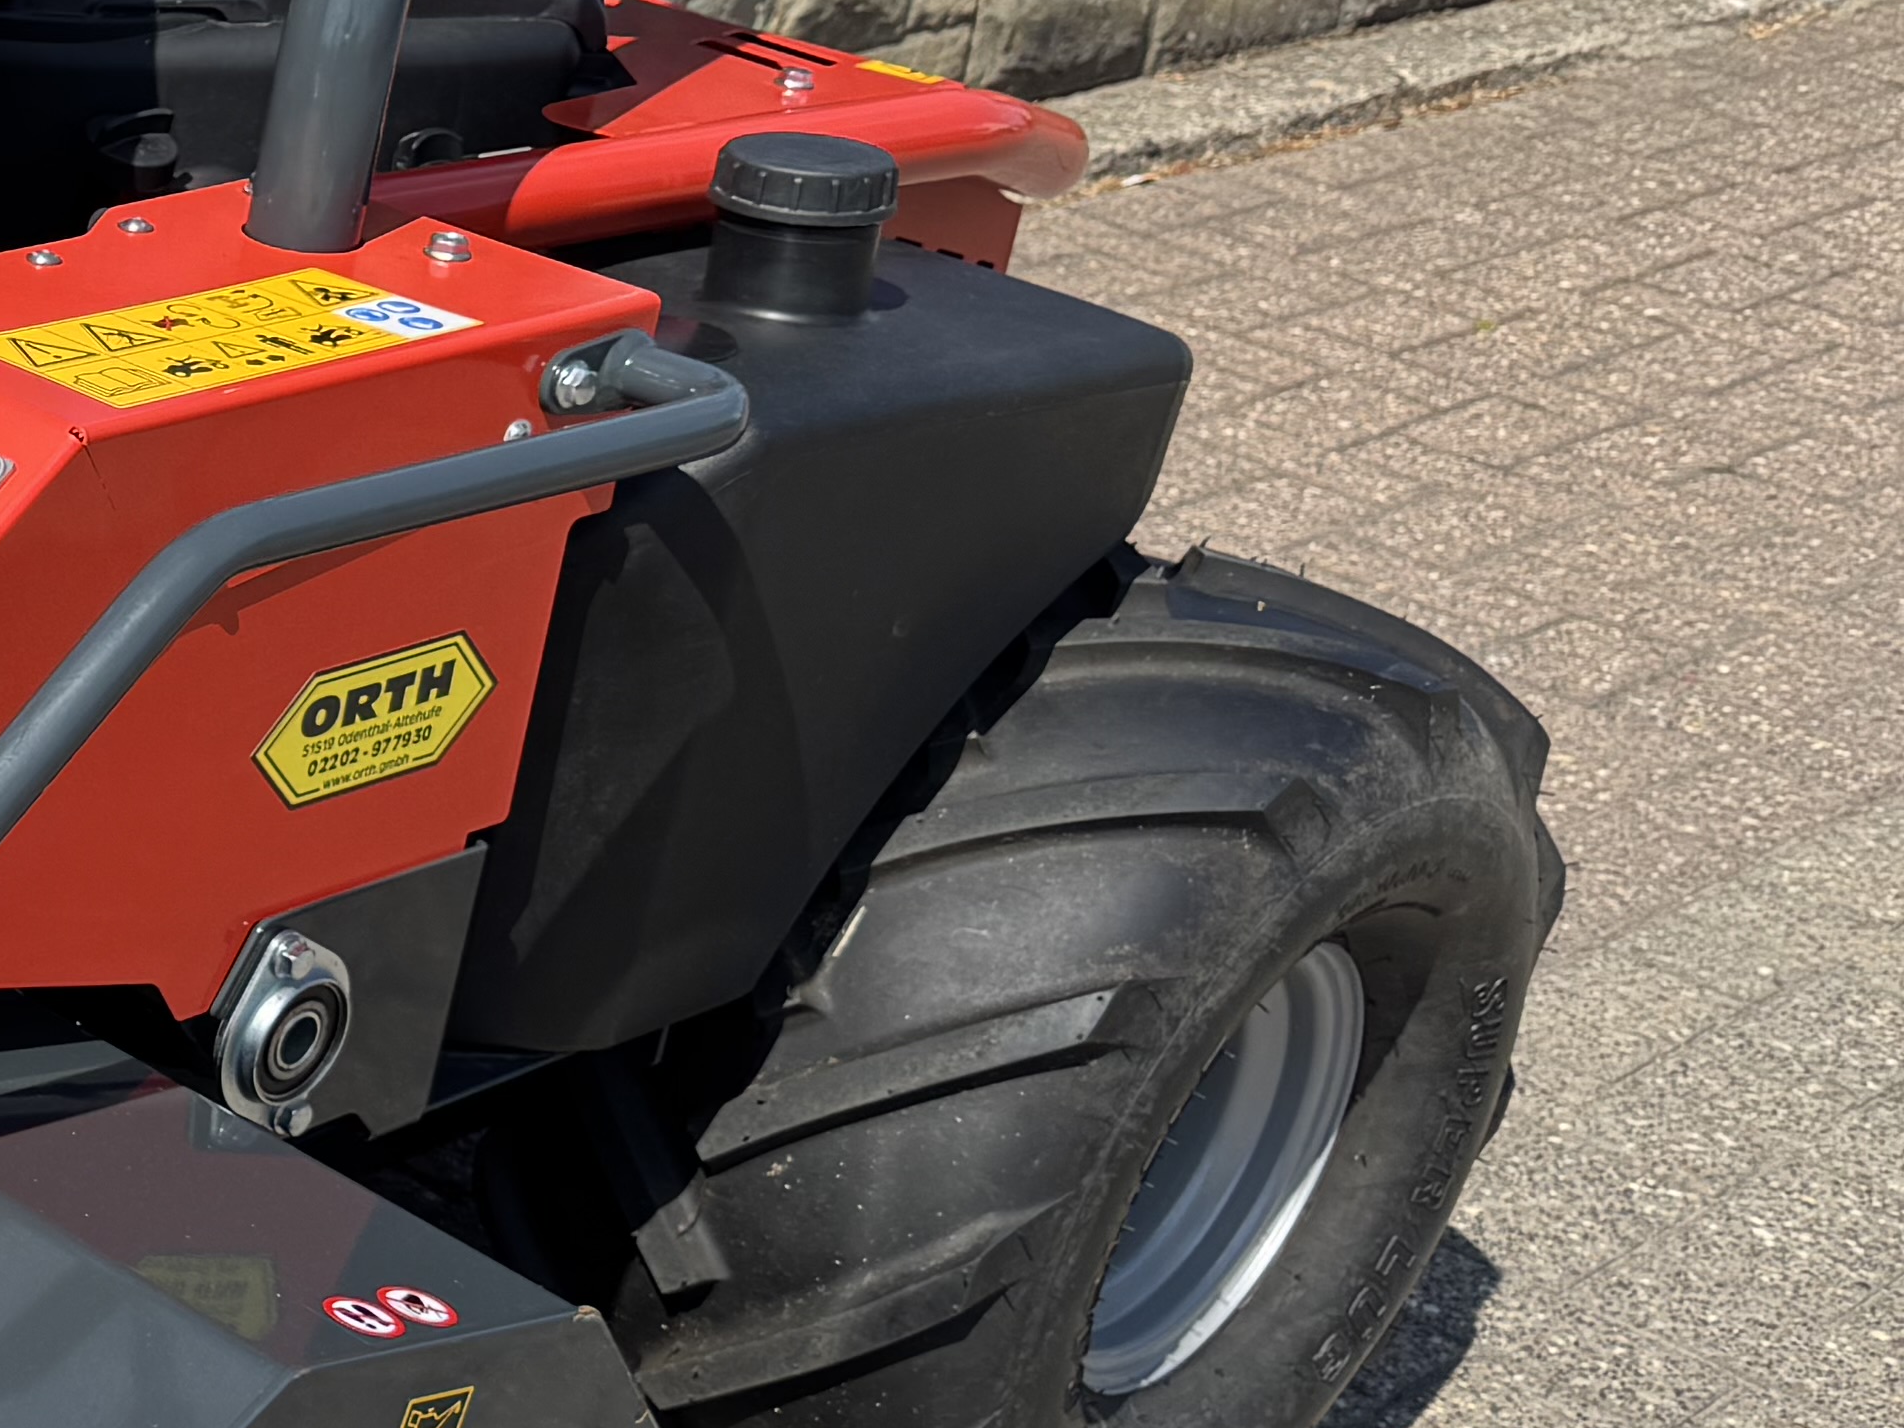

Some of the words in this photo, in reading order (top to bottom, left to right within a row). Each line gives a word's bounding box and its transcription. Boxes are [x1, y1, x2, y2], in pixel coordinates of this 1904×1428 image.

[301, 658, 457, 738] ORTH
[301, 736, 336, 758] 51519
[1410, 976, 1509, 1211] SUPER
[1312, 1234, 1416, 1383] LUG
